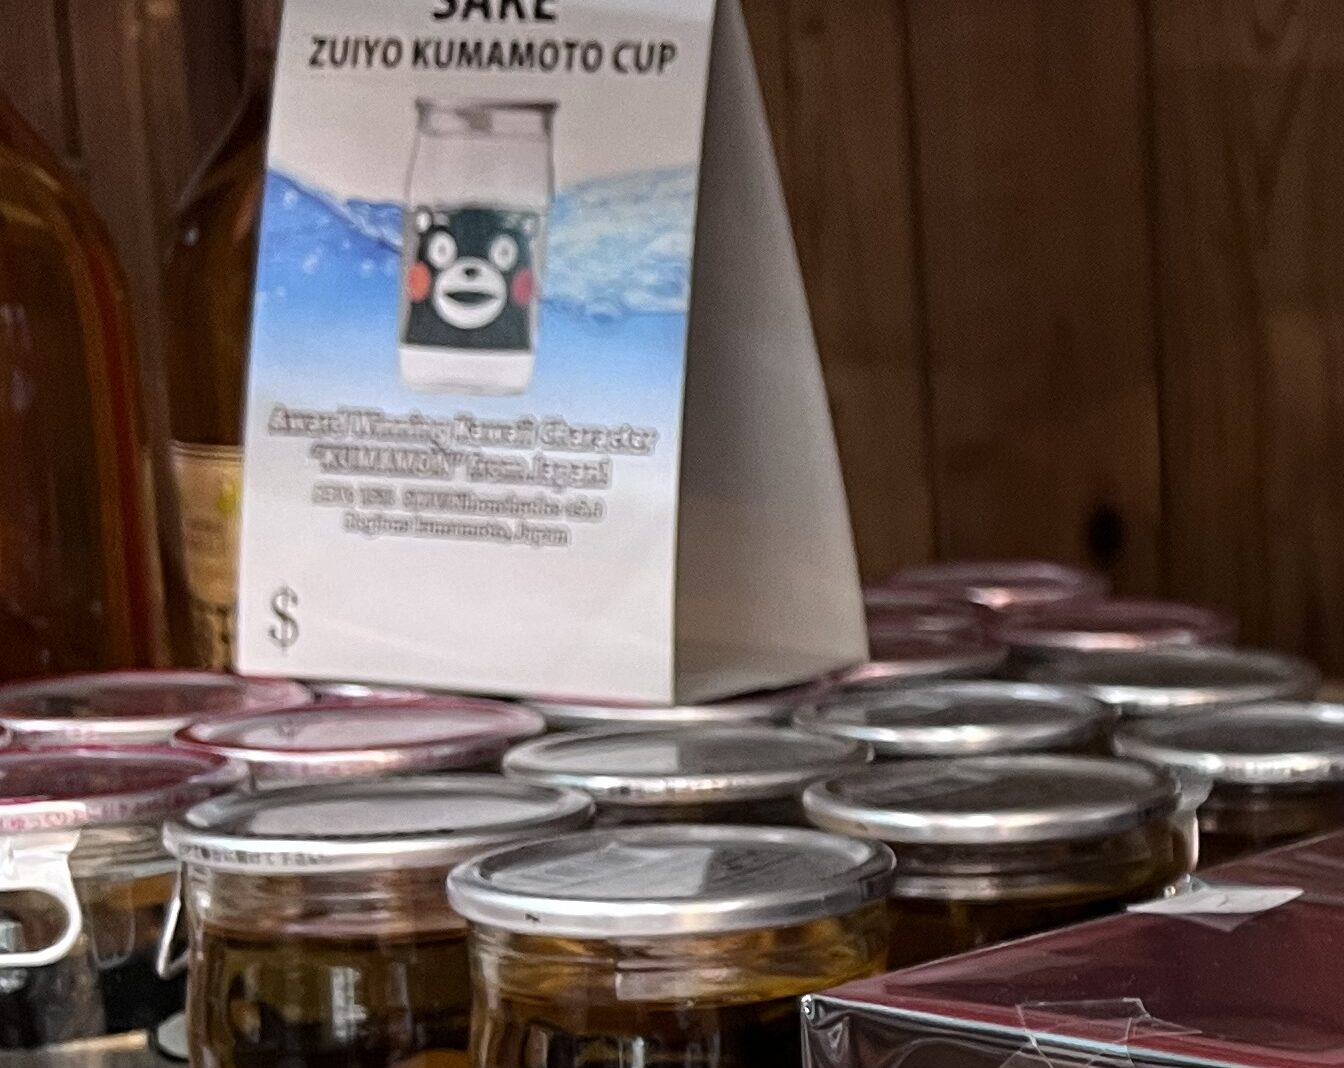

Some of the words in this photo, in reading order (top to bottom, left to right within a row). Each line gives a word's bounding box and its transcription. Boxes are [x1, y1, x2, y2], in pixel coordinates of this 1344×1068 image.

[309, 35, 402, 69] ZUIYO
[412, 37, 602, 73] KUMAMOTO
[612, 40, 678, 75] CUP
[268, 585, 298, 656] $
